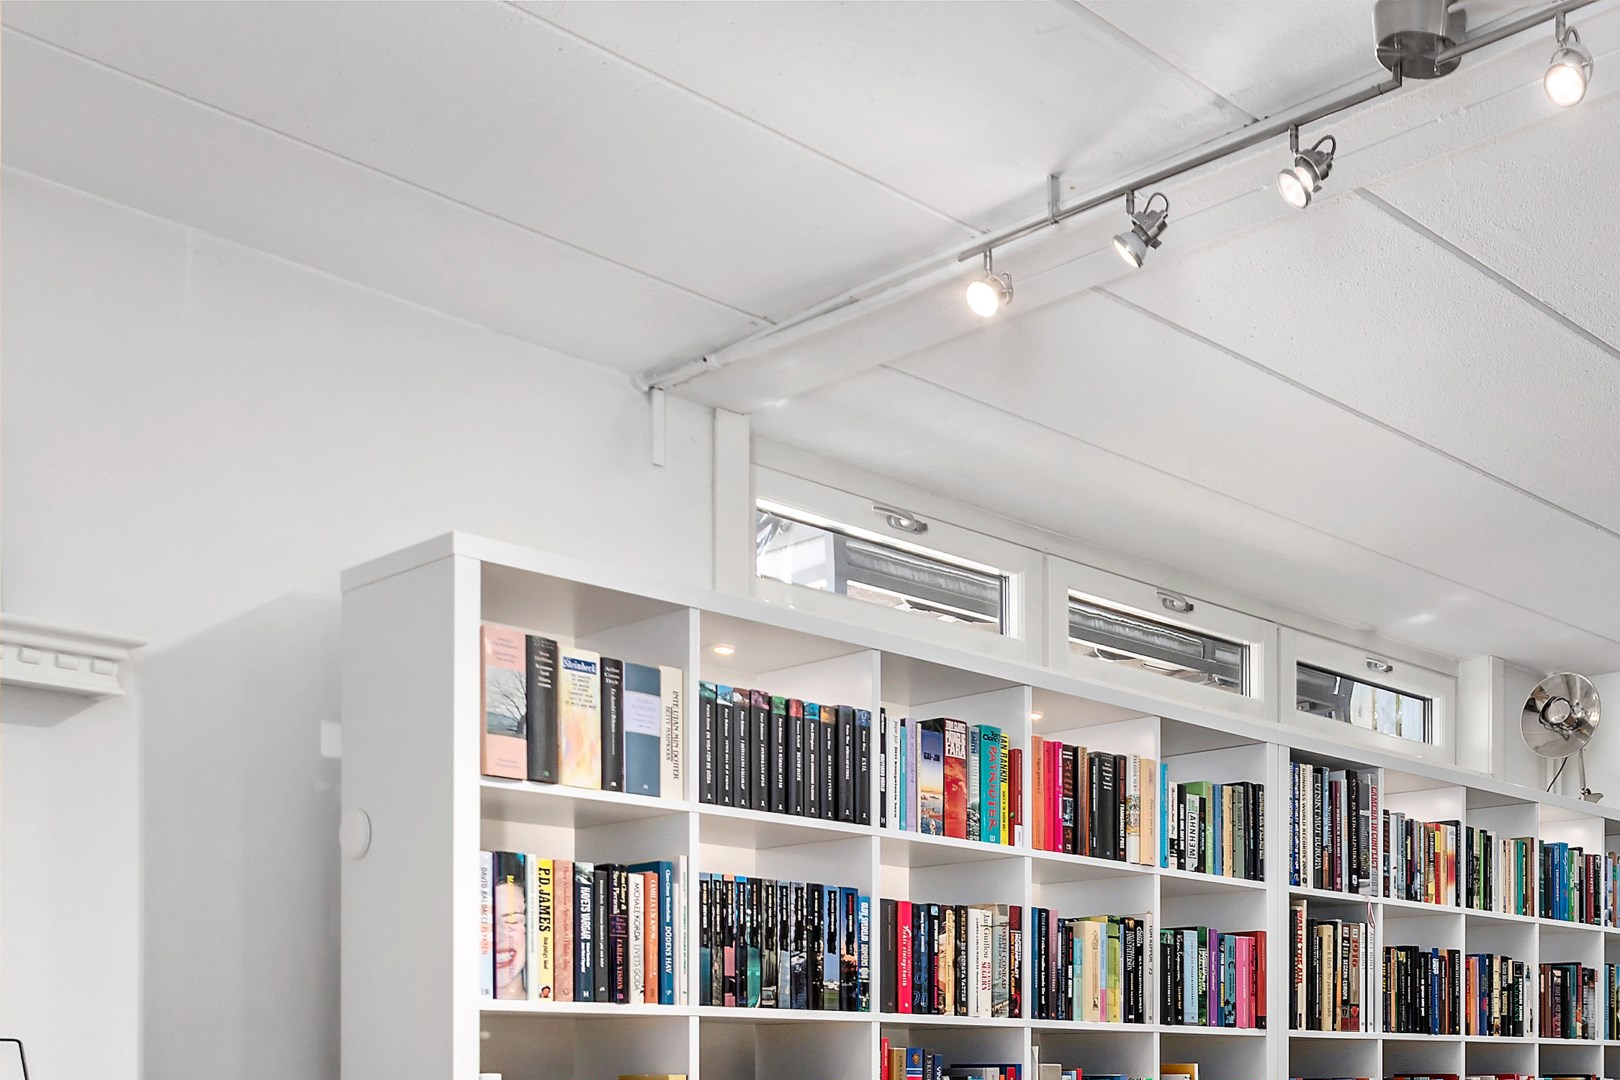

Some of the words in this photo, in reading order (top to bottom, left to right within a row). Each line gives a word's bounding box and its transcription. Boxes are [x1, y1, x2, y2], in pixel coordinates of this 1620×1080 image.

[563, 657, 596, 674] Steinbeck
[988, 746, 997, 831] PATRIOTER
[1372, 823, 1377, 831] IN
[538, 889, 550, 932] JAMES
[580, 887, 591, 912] HAVETS
[581, 913, 591, 940] VARGAR
[1297, 934, 1302, 945] IN
